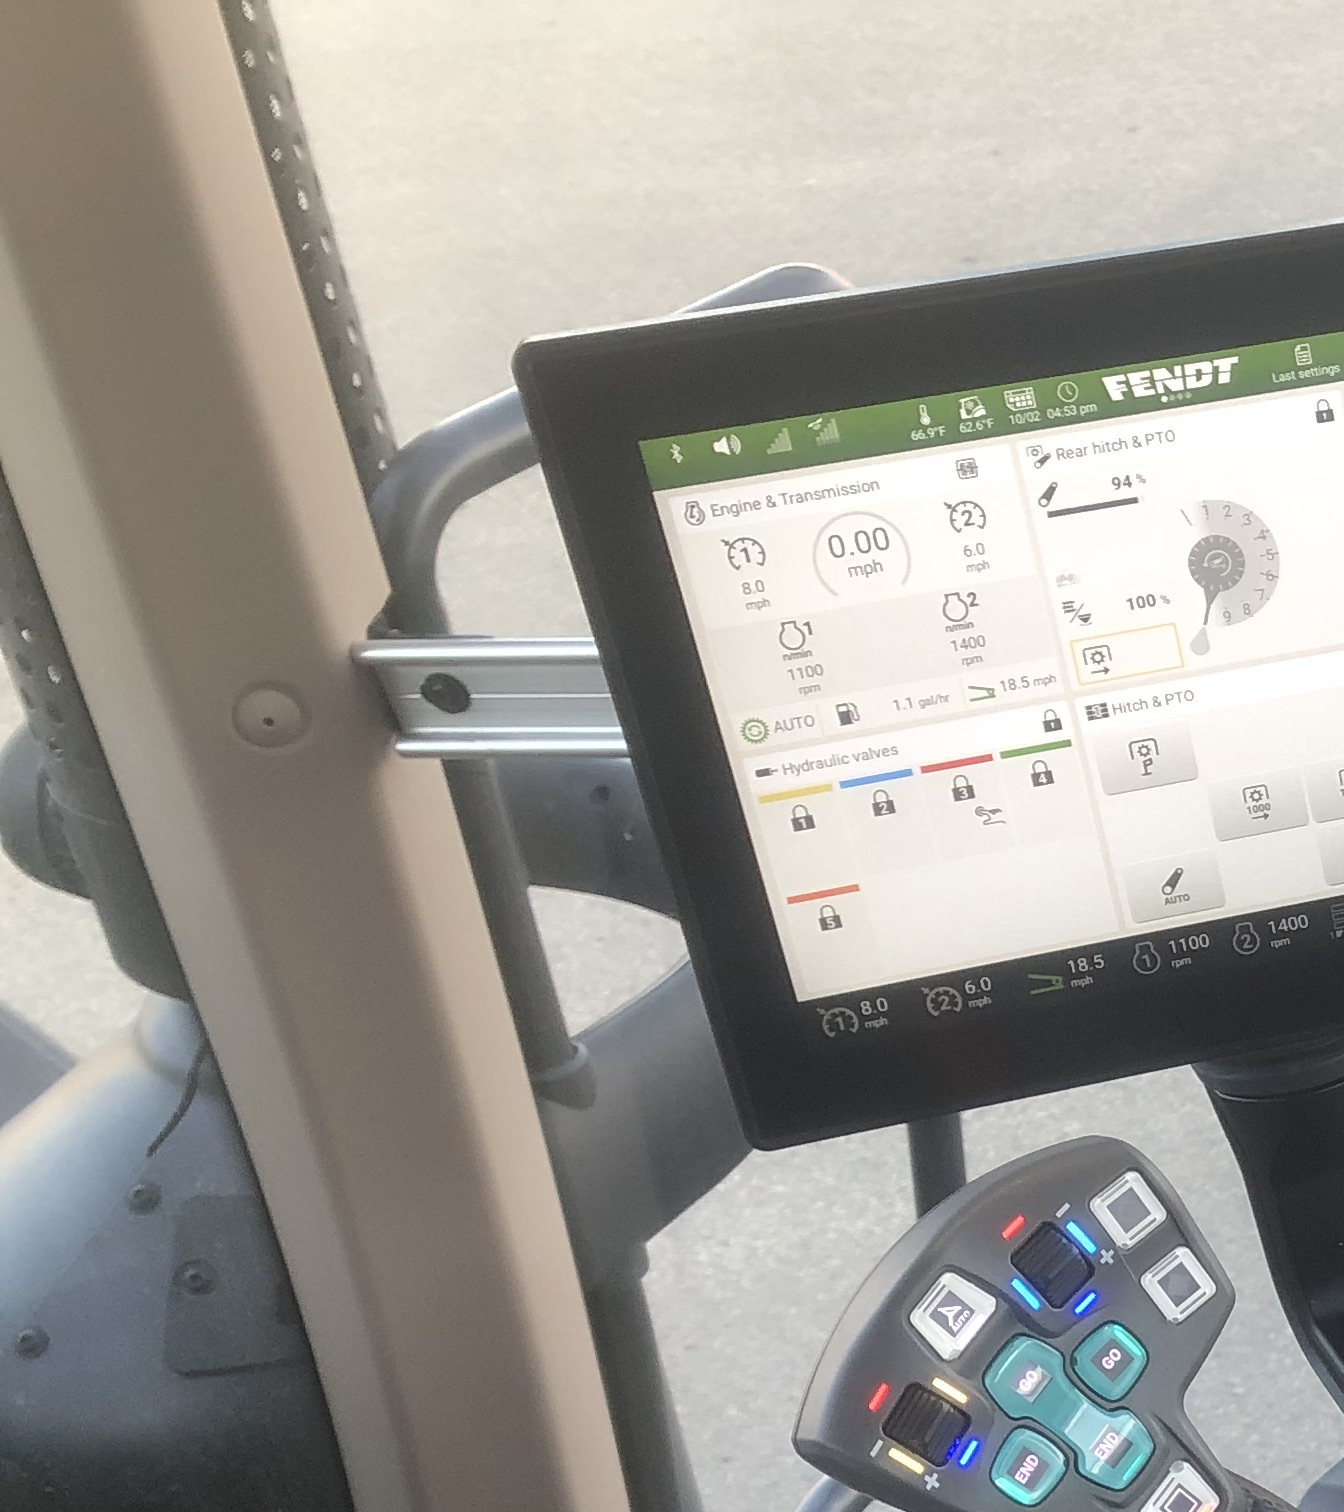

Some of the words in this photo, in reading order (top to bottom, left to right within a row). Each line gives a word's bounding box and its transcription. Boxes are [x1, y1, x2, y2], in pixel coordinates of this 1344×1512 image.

[1101, 356, 1239, 401] FENDT
[1272, 371, 1297, 384] Last
[1298, 363, 1340, 380] settings
[1008, 411, 1042, 425] 10/02
[1046, 404, 1077, 420] 04:53
[1079, 403, 1098, 417] pm
[910, 425, 946, 441] 66.9°F
[959, 417, 995, 433] 62.6°F
[1055, 444, 1089, 461] Rear
[1092, 437, 1129, 455] hitch
[1132, 436, 1143, 449] &
[1144, 429, 1177, 446] PTO
[1111, 474, 1133, 490] 94
[1136, 473, 1147, 484] %
[710, 497, 762, 521] Engine
[765, 494, 777, 508] &
[778, 480, 881, 506] Transmission
[961, 510, 976, 527] 2
[1222, 504, 1233, 517] 2
[1242, 513, 1252, 526] 3
[828, 527, 890, 559] 0.00
[963, 543, 986, 558] 6.0
[848, 559, 884, 580] mph
[966, 560, 990, 574] mph
[741, 580, 766, 596] 8.0
[745, 598, 771, 611] mph
[967, 592, 980, 607] 2
[1126, 594, 1157, 611] 100
[1159, 594, 1171, 605] %
[802, 621, 813, 636] 1
[950, 635, 986, 652] 1400
[962, 653, 984, 667] rpm
[787, 664, 824, 681] 1100
[798, 682, 821, 697] rpm
[1000, 676, 1030, 693] 18.5
[1033, 673, 1057, 689] mph
[892, 697, 914, 712] 1.1
[918, 693, 950, 711] gal/hr
[1111, 697, 1149, 715] Hitch
[1152, 694, 1163, 708] &
[1164, 689, 1195, 706] PTO
[773, 714, 816, 733] AUTO
[781, 754, 849, 778] Hydraulic
[851, 744, 899, 763] valves
[1037, 772, 1048, 785] 4
[958, 787, 969, 799] 3
[879, 802, 890, 815] 2
[1246, 801, 1271, 815] 1000
[1164, 892, 1191, 906] AUTO
[826, 917, 836, 929] 5
[1268, 914, 1310, 935] 1400
[1168, 933, 1210, 955] 1100
[1240, 934, 1253, 949] 2
[1270, 935, 1291, 949] rpm
[1067, 954, 1105, 974] 18.5
[1140, 953, 1151, 967] 1
[1171, 956, 1192, 969] rpm
[964, 976, 993, 995] 6.0
[1070, 975, 1094, 988] mph
[860, 997, 889, 1016] 8.0
[938, 995, 952, 1010] 2
[968, 995, 993, 1008] mph
[864, 1016, 889, 1029] mph
[951, 1309, 971, 1333] AUTO
[1101, 1347, 1122, 1370] GO
[1018, 1368, 1039, 1394] GO
[1094, 1430, 1121, 1461] END
[1014, 1454, 1041, 1485] END
